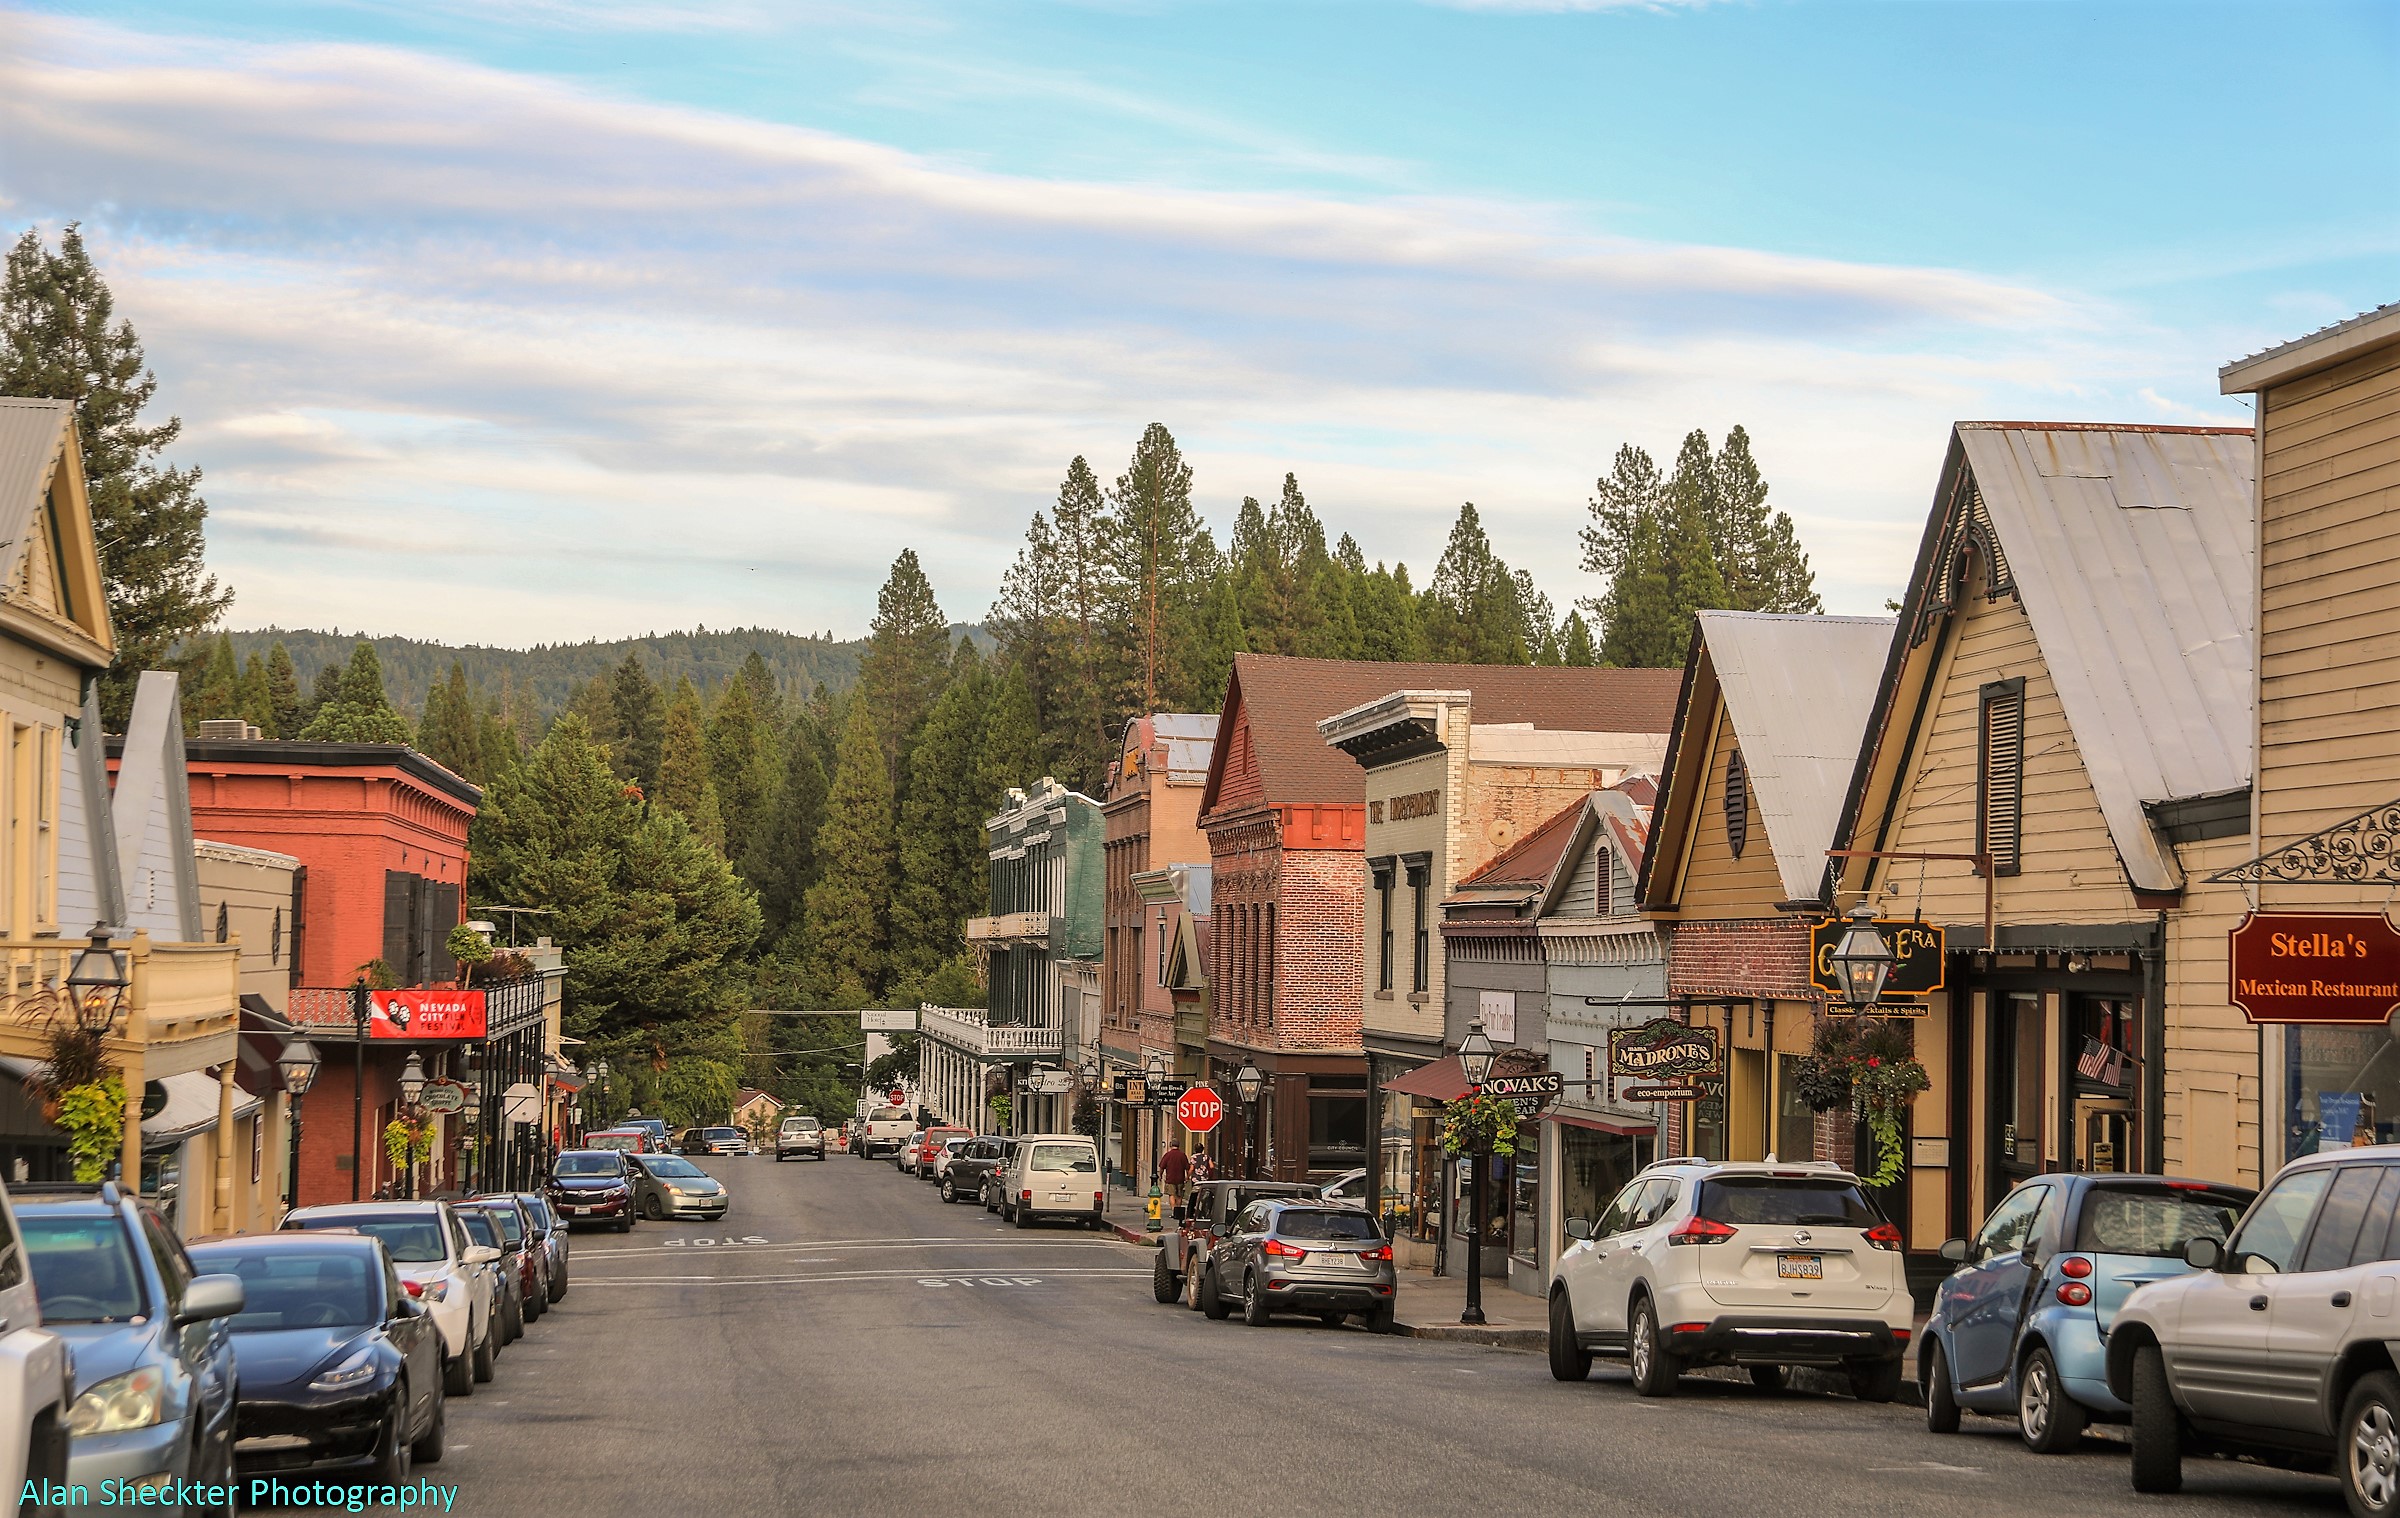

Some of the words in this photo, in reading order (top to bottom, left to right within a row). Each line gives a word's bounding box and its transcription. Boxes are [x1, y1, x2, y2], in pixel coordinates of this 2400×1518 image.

[1369, 800, 1384, 824] THE
[2270, 932, 2367, 958] Stella's
[2239, 978, 2307, 996] Mexican
[2310, 979, 2398, 997] Restaurant
[420, 1003, 467, 1012] NEVADA
[1829, 1006, 1856, 1014] Classic
[1866, 1006, 1892, 1014] cktails
[420, 1013, 444, 1022] CITY
[420, 1022, 465, 1031] FESTIVAL
[1619, 1043, 1711, 1067] MADRONE'S
[1195, 1080, 1209, 1088] PINE
[1480, 1076, 1558, 1095] NOVAK'S
[1637, 1086, 1693, 1099] eco-emporium
[1512, 1096, 1538, 1107] EN'S
[1179, 1101, 1219, 1118] STOP
[1515, 1106, 1537, 1115] EAR
[663, 1235, 768, 1247] STOP
[1781, 1262, 1820, 1274] 8JHS839
[916, 1277, 1043, 1288] STOP
